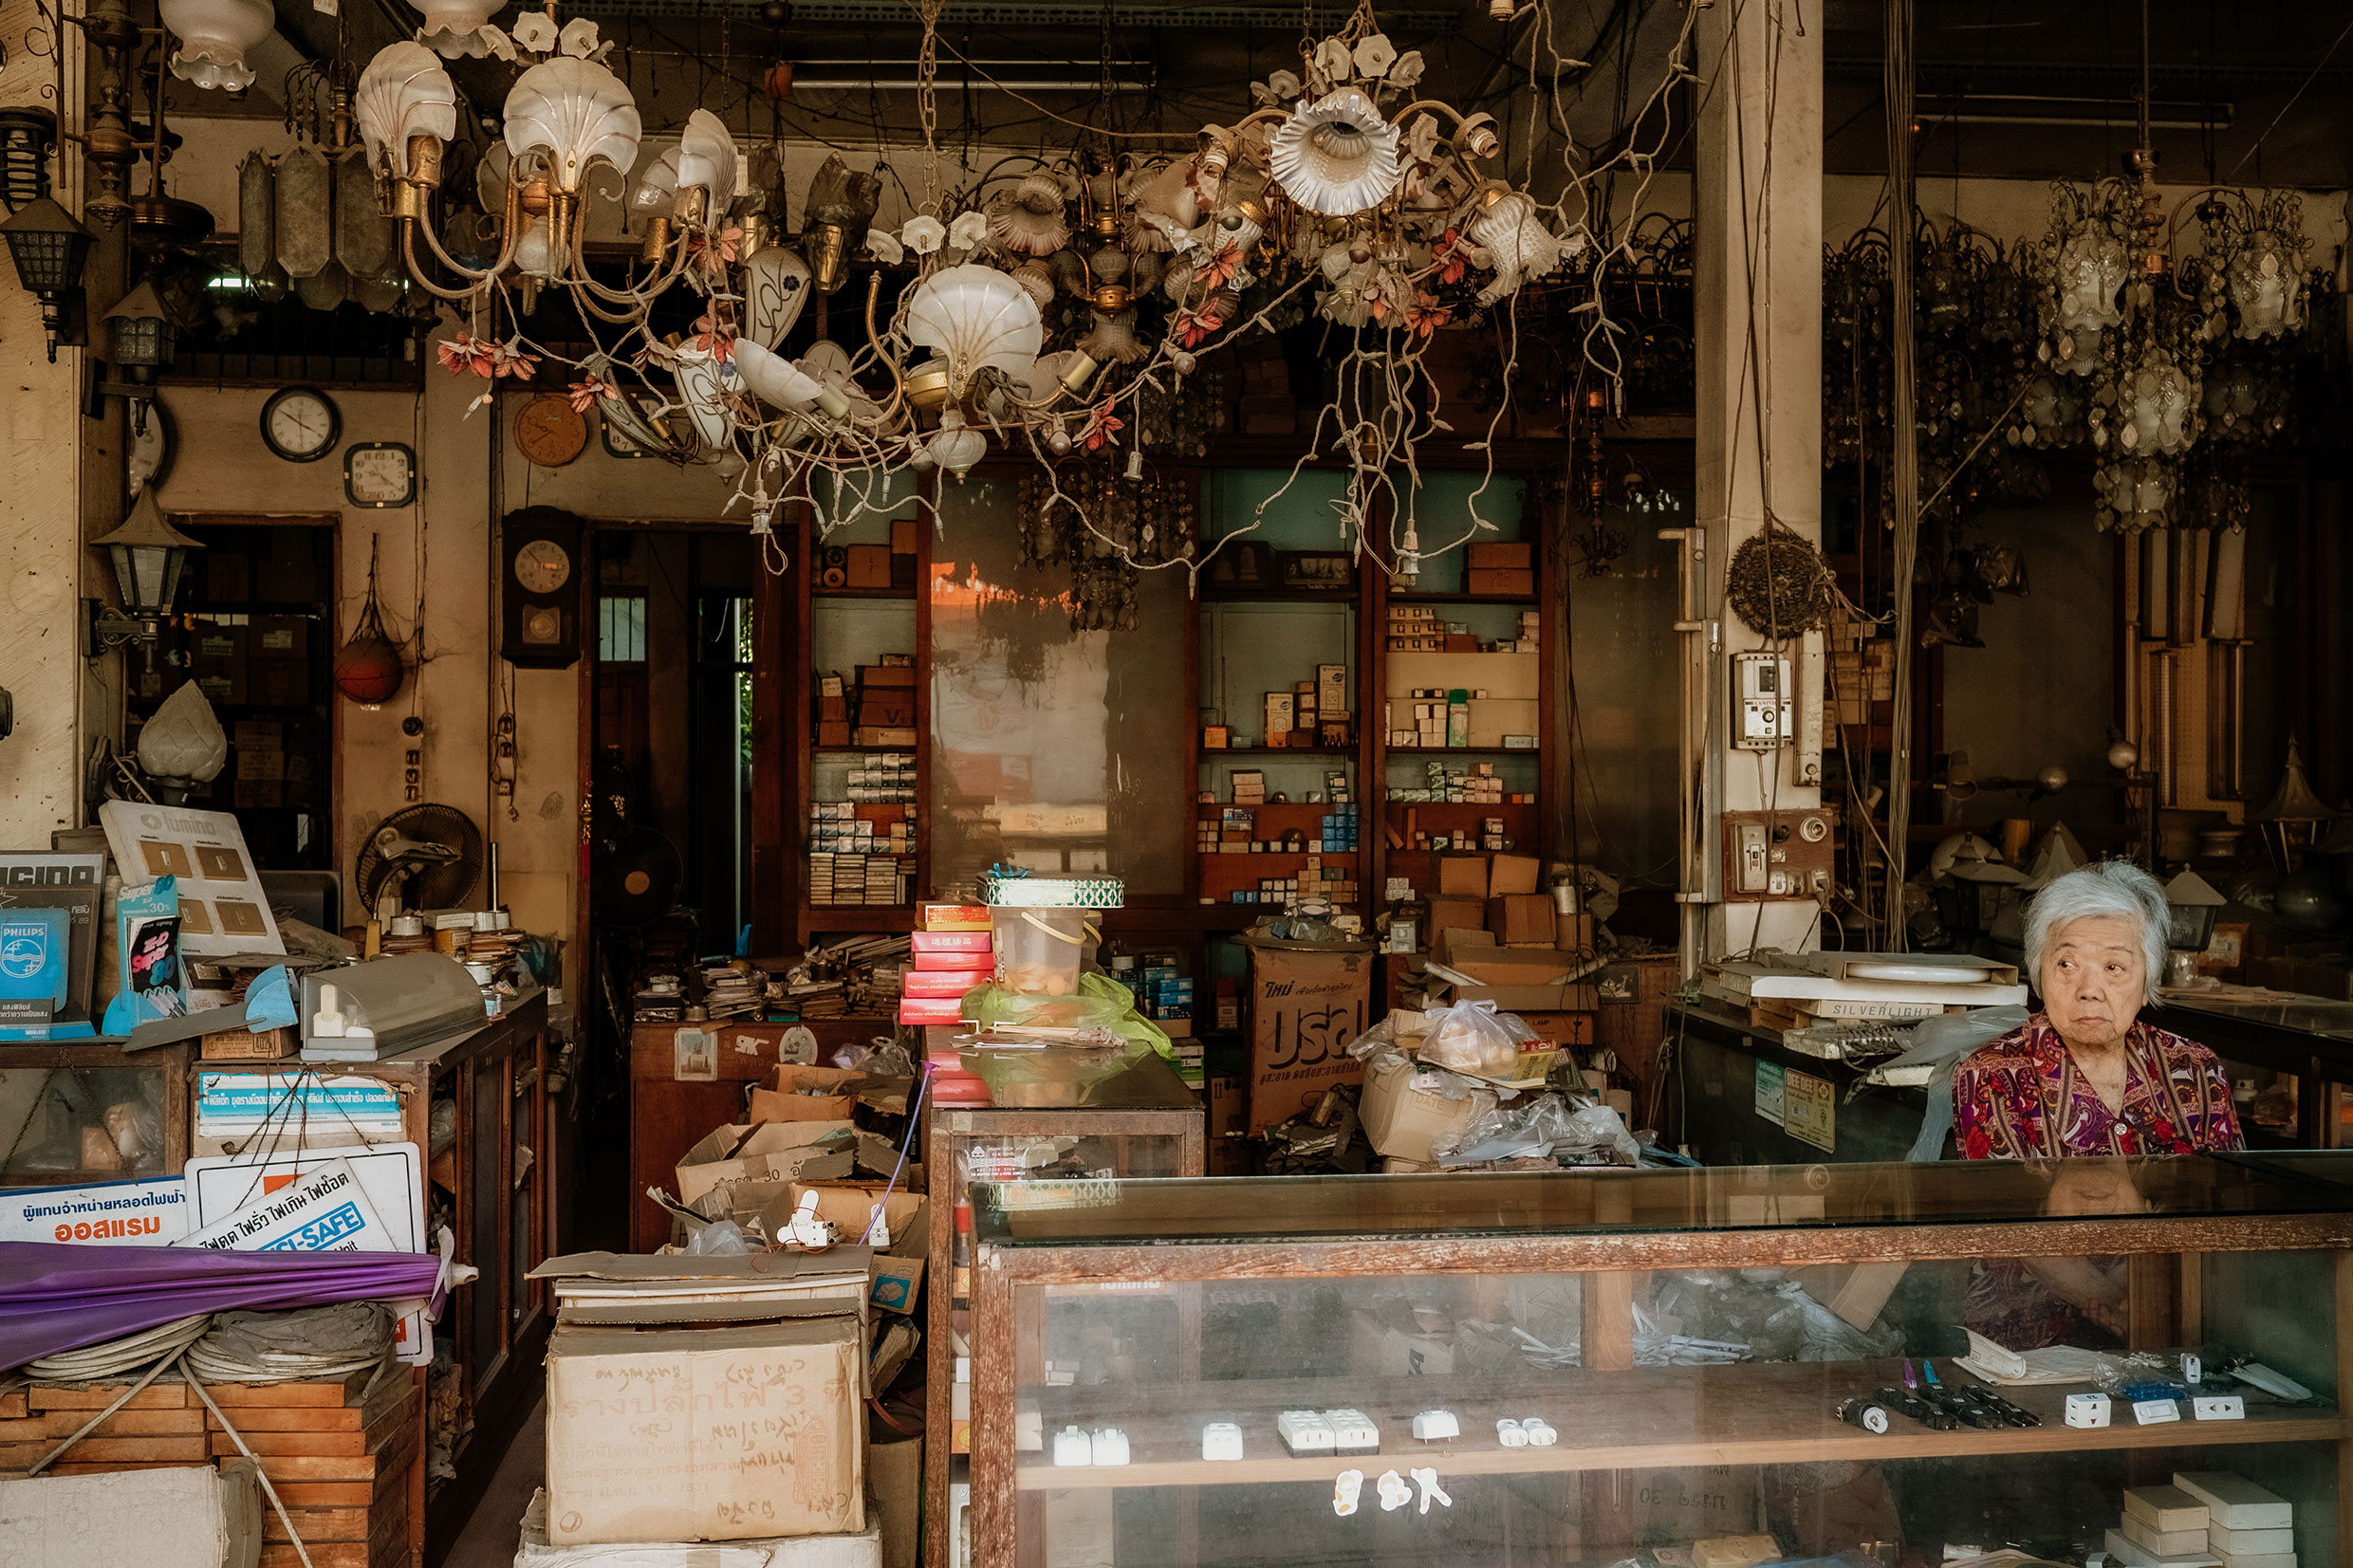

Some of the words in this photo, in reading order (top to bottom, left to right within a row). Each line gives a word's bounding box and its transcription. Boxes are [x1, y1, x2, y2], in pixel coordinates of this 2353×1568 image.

[161, 811, 216, 836] lumino
[118, 882, 157, 902] Super
[4, 928, 45, 937] PHILIPS
[131, 943, 170, 974] Super
[150, 954, 176, 986] 80
[1266, 981, 1295, 999] ใหม่
[1833, 1005, 1932, 1017] SILVERLIGHT
[1788, 1072, 1800, 1089] DEE
[1800, 1076, 1813, 1094] DEE
[1416, 1095, 1444, 1111] DATE
[763, 1169, 780, 1183] 30
[23, 1190, 186, 1222] ผู้แทนจำหน่ายหลอดไฟฟ้า
[233, 1210, 270, 1237] ไฟรั่ว
[265, 1195, 307, 1221] ไฟเกิน
[55, 1216, 161, 1243] ออสแรม
[334, 1241, 359, 1251] nit
[785, 1385, 806, 1406] 3
